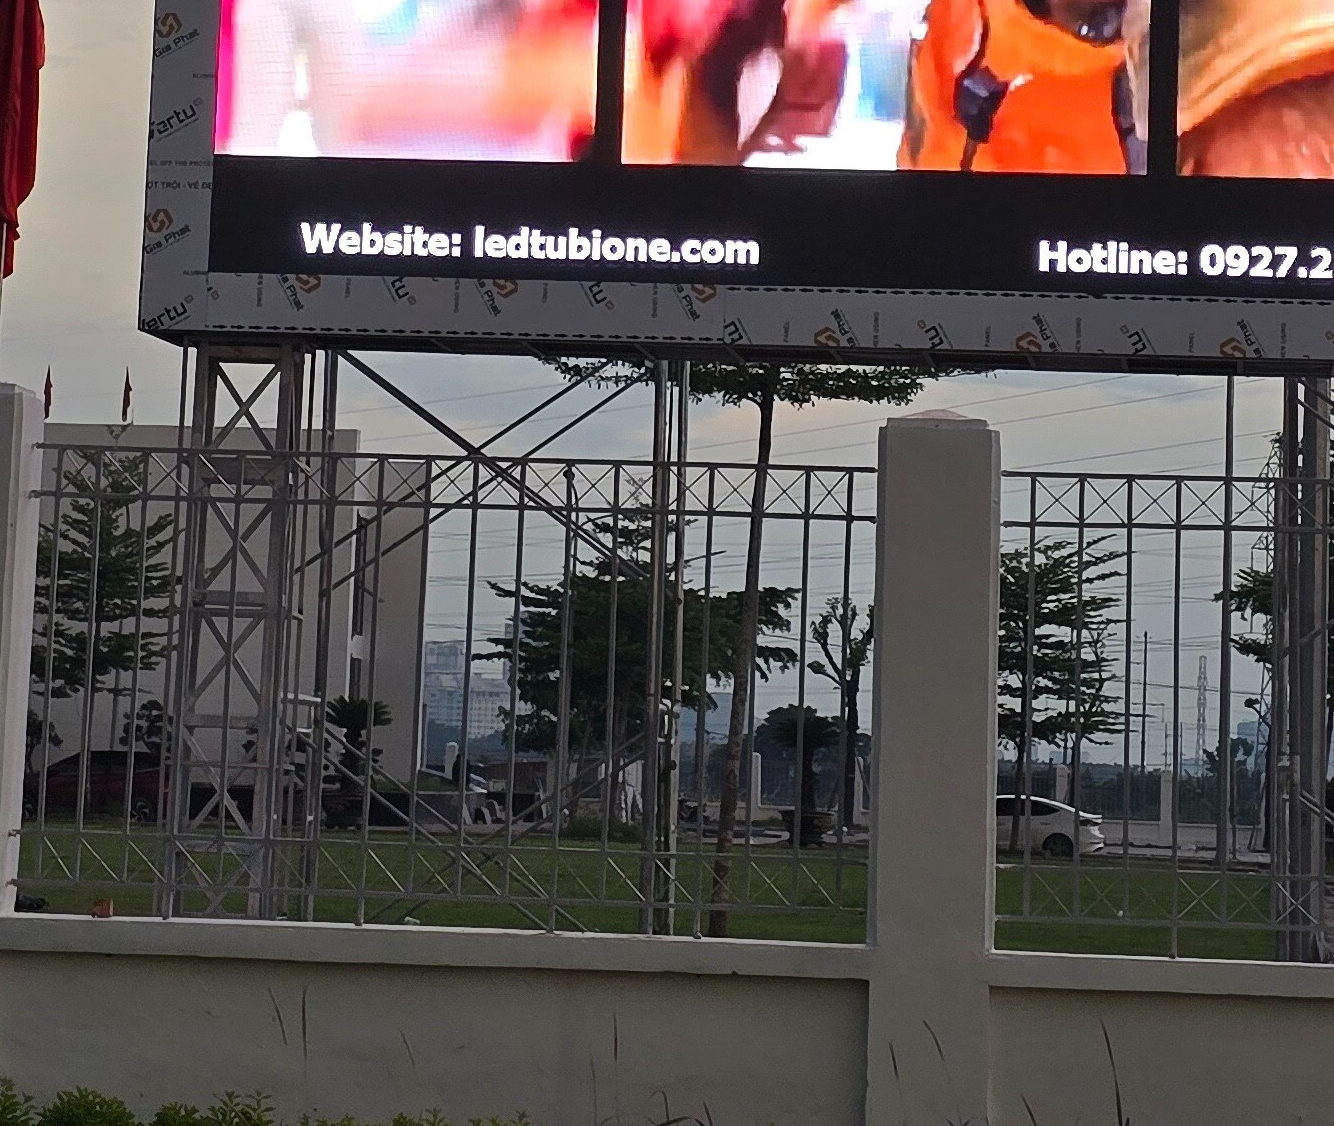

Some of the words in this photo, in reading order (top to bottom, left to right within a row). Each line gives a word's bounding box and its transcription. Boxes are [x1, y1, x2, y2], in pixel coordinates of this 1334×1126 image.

[173, 28, 200, 46] Phat
[164, 224, 192, 244] Phat
[299, 220, 462, 259] Website:
[473, 224, 760, 266] ledtubione.com
[1038, 239, 1188, 276] Hotline:
